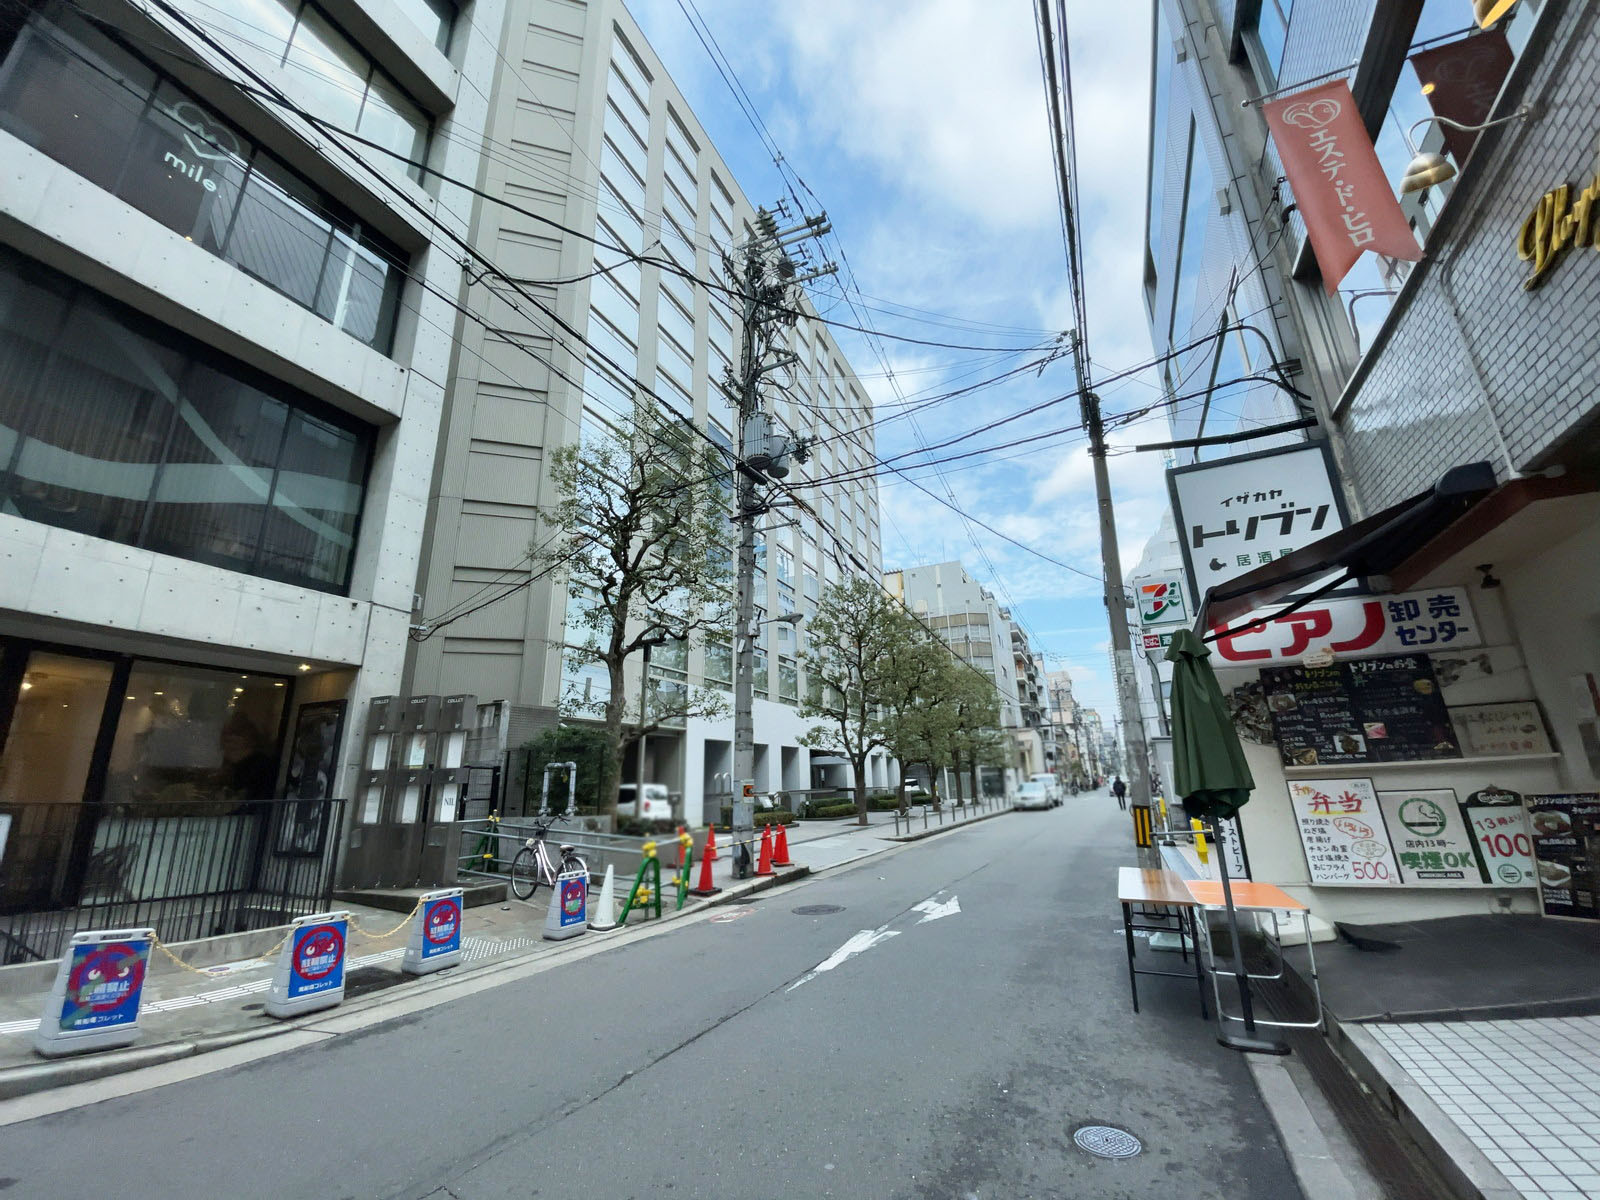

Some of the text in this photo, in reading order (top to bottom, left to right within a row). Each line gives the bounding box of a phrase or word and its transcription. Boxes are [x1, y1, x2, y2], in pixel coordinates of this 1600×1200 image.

[1220, 488, 1283, 508] イザカヤ
[1192, 501, 1331, 549] トリブン
[1387, 594, 1461, 623] 卸売
[1395, 620, 1470, 647] センター
[1307, 790, 1363, 814] 弁当
[1352, 861, 1389, 880] 500
